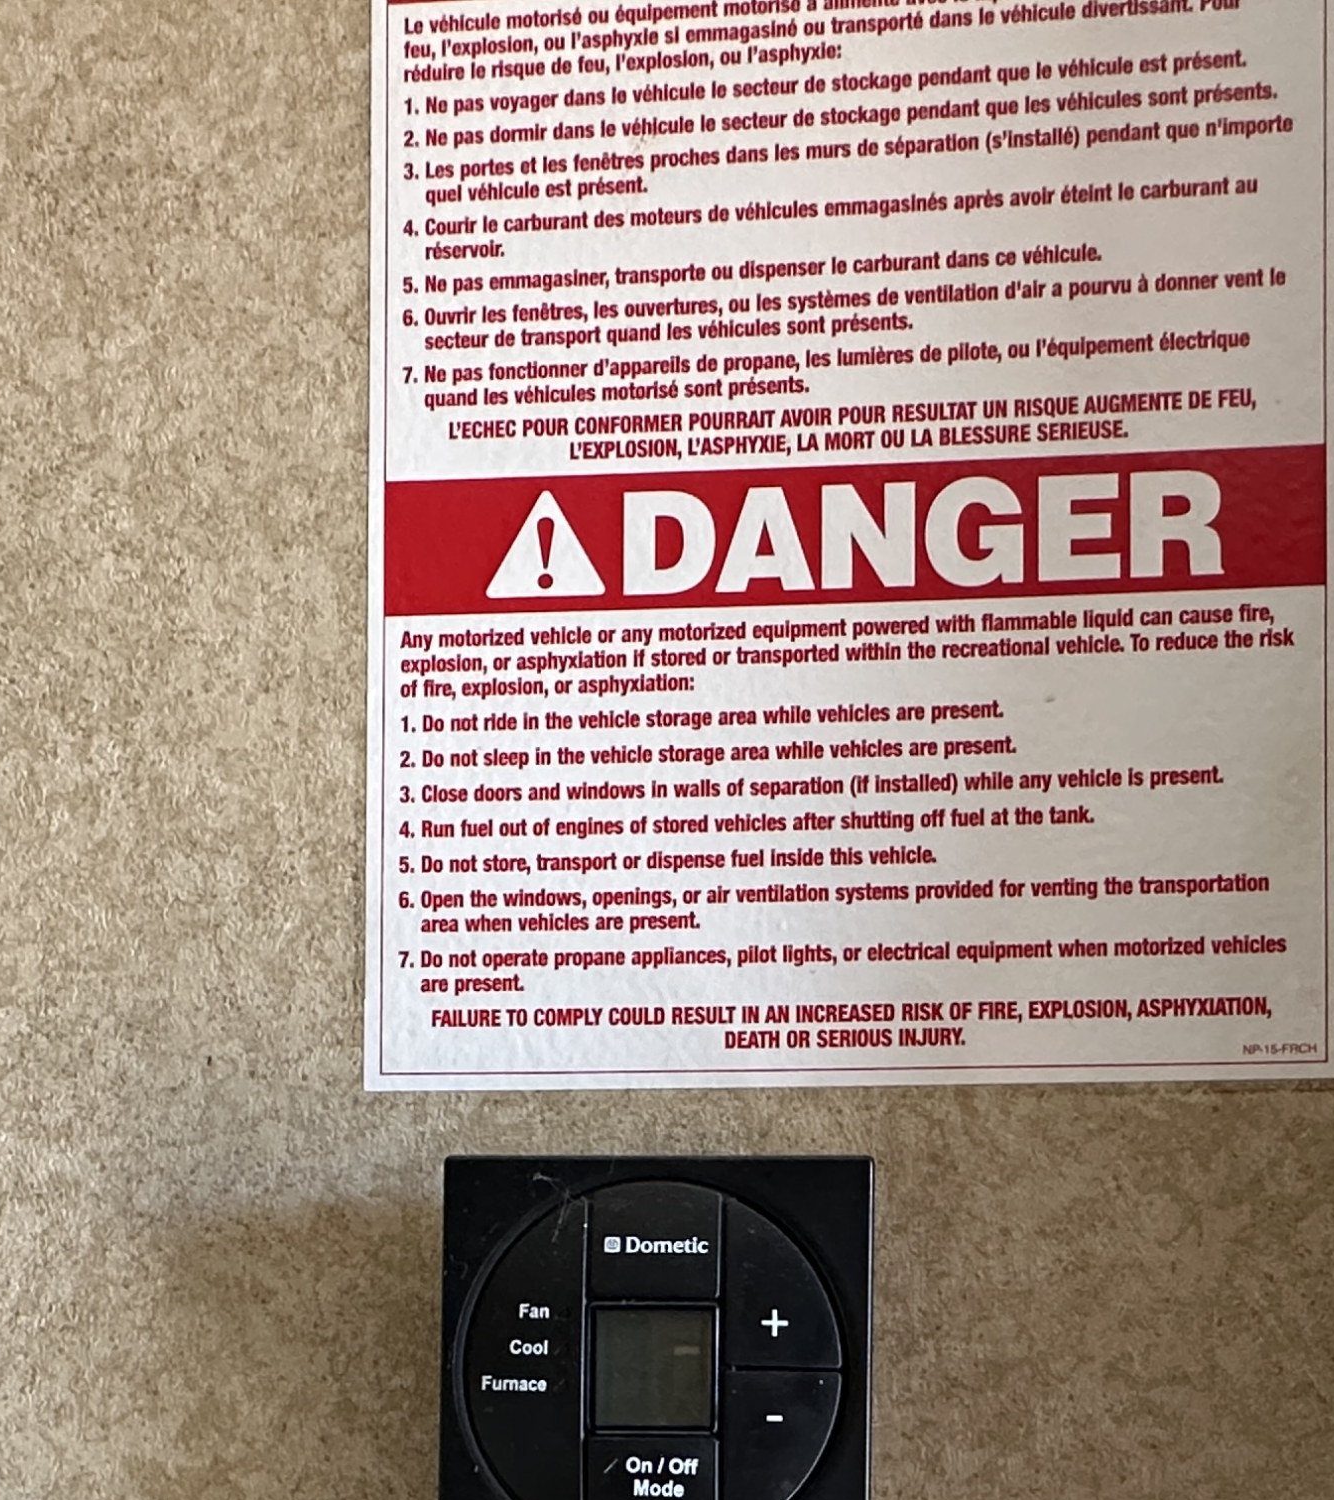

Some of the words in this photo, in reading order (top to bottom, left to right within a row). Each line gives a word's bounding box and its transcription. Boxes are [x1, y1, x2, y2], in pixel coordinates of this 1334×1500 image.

[425, 95, 448, 115] Ne
[453, 96, 484, 117] pas
[489, 92, 559, 114] voyager
[562, 87, 606, 107] dans
[611, 85, 627, 105] le
[631, 81, 706, 103] véhicule
[710, 79, 727, 99] le
[732, 77, 799, 98] secteur
[803, 74, 826, 94] de
[830, 70, 912, 93] stockage
[917, 64, 991, 91] pendant
[996, 65, 1030, 86] que
[1035, 60, 1052, 80] le
[1057, 55, 1133, 79] véhicule
[1138, 52, 1168, 73] est
[424, 183, 462, 207] quel
[467, 180, 540, 201] véhicule
[544, 178, 572, 198] est
[424, 274, 447, 293] Ne
[452, 276, 483, 296] pas
[613, 262, 706, 287] transporte
[710, 264, 733, 281] ou
[738, 259, 826, 282] dispenser
[830, 255, 847, 275] le
[852, 250, 940, 274] carburant
[945, 249, 990, 269] dans
[994, 250, 1017, 267] ce
[424, 330, 489, 350] secteur
[493, 328, 516, 348] de
[519, 325, 601, 349] transport
[605, 321, 661, 347] quand
[666, 321, 692, 341] les
[696, 317, 781, 339] véhicules
[786, 314, 826, 336] sont
[423, 387, 478, 412] quand
[482, 386, 509, 406] les
[513, 383, 596, 405] véhicules
[601, 378, 679, 402] motorisé
[683, 377, 723, 398] sont
[623, 469, 1225, 596] DANGER
[399, 629, 433, 652] Any
[437, 626, 525, 648] motorized
[529, 625, 592, 645] vehicle
[596, 628, 616, 644] or
[620, 627, 653, 646] any
[657, 620, 746, 642] motorized
[751, 617, 847, 642] equipment
[851, 614, 930, 639] powered
[934, 613, 976, 633] with
[980, 609, 1077, 632] flammable
[1082, 607, 1134, 631] liquid
[1139, 609, 1173, 626] can
[1178, 607, 1233, 625] cause
[1237, 602, 1274, 626] fire,
[399, 653, 488, 677] explosion,
[492, 655, 512, 671] or
[515, 649, 627, 674] asphyxiation
[632, 647, 645, 668] if
[650, 646, 707, 668] stored
[711, 650, 731, 666] or
[735, 642, 840, 667] transported
[844, 641, 901, 662] within
[906, 640, 936, 660] the
[941, 635, 1050, 659] recreational
[1054, 633, 1125, 655] vehicle.
[1128, 632, 1150, 652] To
[1154, 630, 1219, 651] reduce
[1223, 628, 1254, 649] the
[1258, 626, 1295, 647] risk
[399, 678, 418, 698] of
[422, 678, 456, 701] fire,
[460, 676, 549, 700] explosion,
[553, 679, 573, 694] or
[577, 672, 695, 698] asphyxiation:
[399, 784, 415, 803] 3.
[420, 783, 468, 803] Close
[473, 783, 522, 802] doors
[527, 781, 560, 801] and
[565, 780, 645, 800] windows
[650, 779, 668, 798] in
[672, 777, 721, 798] walls
[725, 776, 744, 797] of
[748, 775, 844, 800] separation
[849, 773, 870, 798] (if
[874, 771, 958, 796] installed)
[963, 770, 1014, 791] while
[1018, 773, 1052, 793] any
[1056, 767, 1122, 788] vehicle
[1127, 766, 1144, 787] is
[1149, 764, 1224, 790] present.
[398, 855, 415, 874] 5.
[420, 854, 443, 873] Do
[448, 853, 478, 873] not
[482, 853, 531, 876] store,
[535, 851, 617, 875] transport
[621, 854, 642, 870] or
[645, 850, 726, 873] dispense
[729, 848, 764, 868] fuel
[769, 846, 824, 867] inside
[828, 846, 864, 866] this
[867, 844, 937, 865] vehicle.
[420, 917, 459, 933] area
[463, 913, 512, 932] when
[517, 912, 589, 932] vehicles
[594, 915, 624, 930] are
[628, 910, 700, 934] present.
[430, 1008, 501, 1027] FAILURE
[504, 1007, 528, 1027] TO
[532, 1007, 603, 1027] COMPLY
[607, 1006, 665, 1026] COULD
[670, 1005, 737, 1025] RESULT
[740, 1004, 760, 1024] IN
[763, 1004, 790, 1024] AN
[795, 1002, 895, 1023] INCREASED
[900, 1001, 944, 1022] RISK
[948, 1001, 973, 1021] OF
[977, 1000, 1023, 1023] FIRE,
[1027, 998, 1132, 1022] EXPLOSION,
[1135, 995, 1272, 1019] ASPHYXIATION,
[723, 1029, 780, 1049] DEATH
[785, 1029, 810, 1049] OR
[815, 1027, 893, 1049] SERIOUS
[897, 1026, 966, 1047] INJURY.
[625, 1236, 709, 1254] Dometic
[518, 1302, 550, 1319] Fan
[509, 1339, 549, 1356] Cool
[481, 1375, 548, 1392] Furnace
[625, 1456, 652, 1474] On
[668, 1457, 699, 1476] Off
[633, 1478, 685, 1498] Mode
